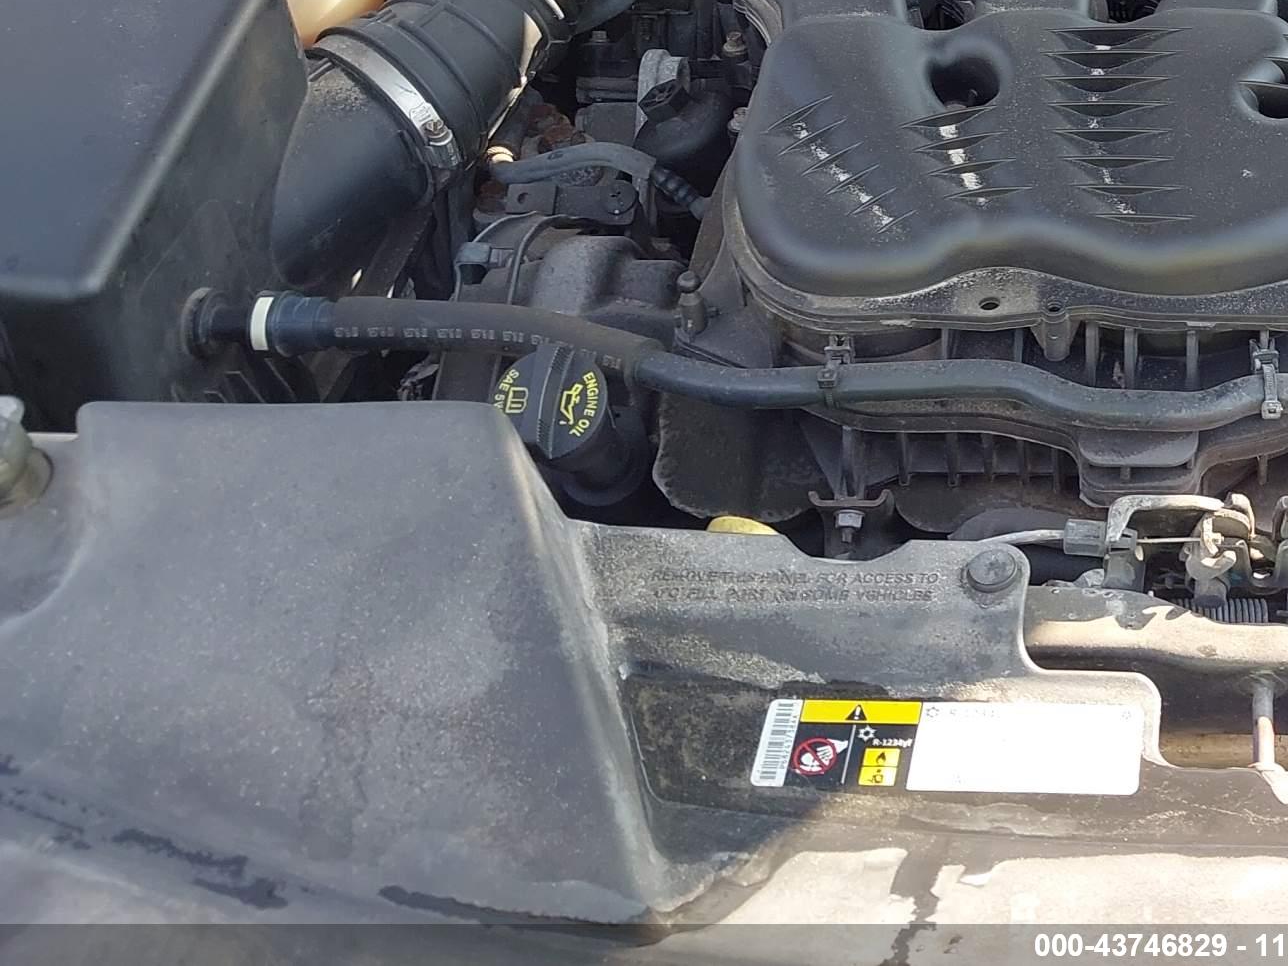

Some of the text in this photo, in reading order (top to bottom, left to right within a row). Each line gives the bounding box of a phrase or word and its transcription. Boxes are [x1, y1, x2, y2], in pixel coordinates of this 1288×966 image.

[498, 369, 520, 391] SAE
[569, 371, 599, 437] ENGINE OIL
[815, 572, 848, 584] FOR
[851, 572, 914, 584] ACCESS
[919, 573, 940, 584] TO
[855, 589, 934, 602] VEHICLES
